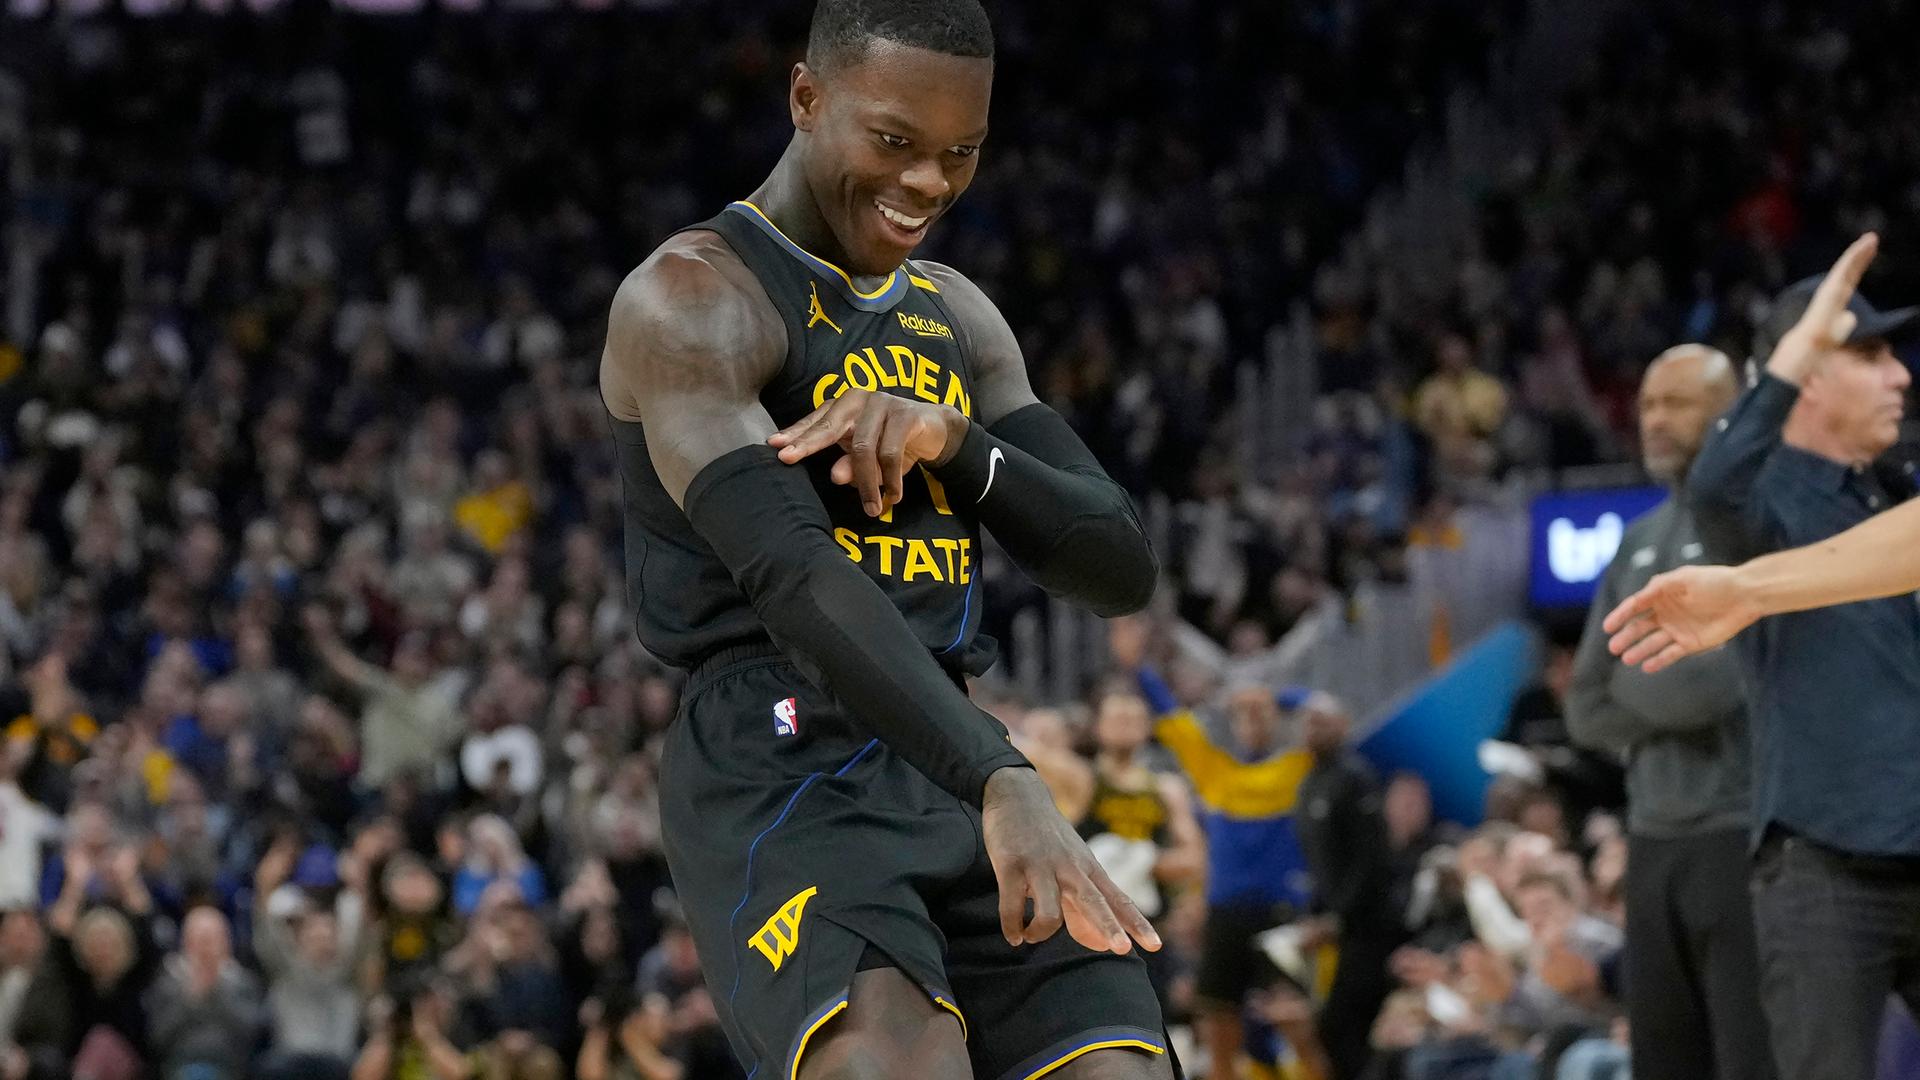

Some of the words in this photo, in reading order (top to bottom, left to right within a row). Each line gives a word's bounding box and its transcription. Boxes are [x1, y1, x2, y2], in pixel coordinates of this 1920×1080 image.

[897, 312, 954, 340] Rakuten
[812, 345, 971, 418] GOLDEN
[834, 527, 970, 585] STATE
[777, 725, 790, 736] NBA
